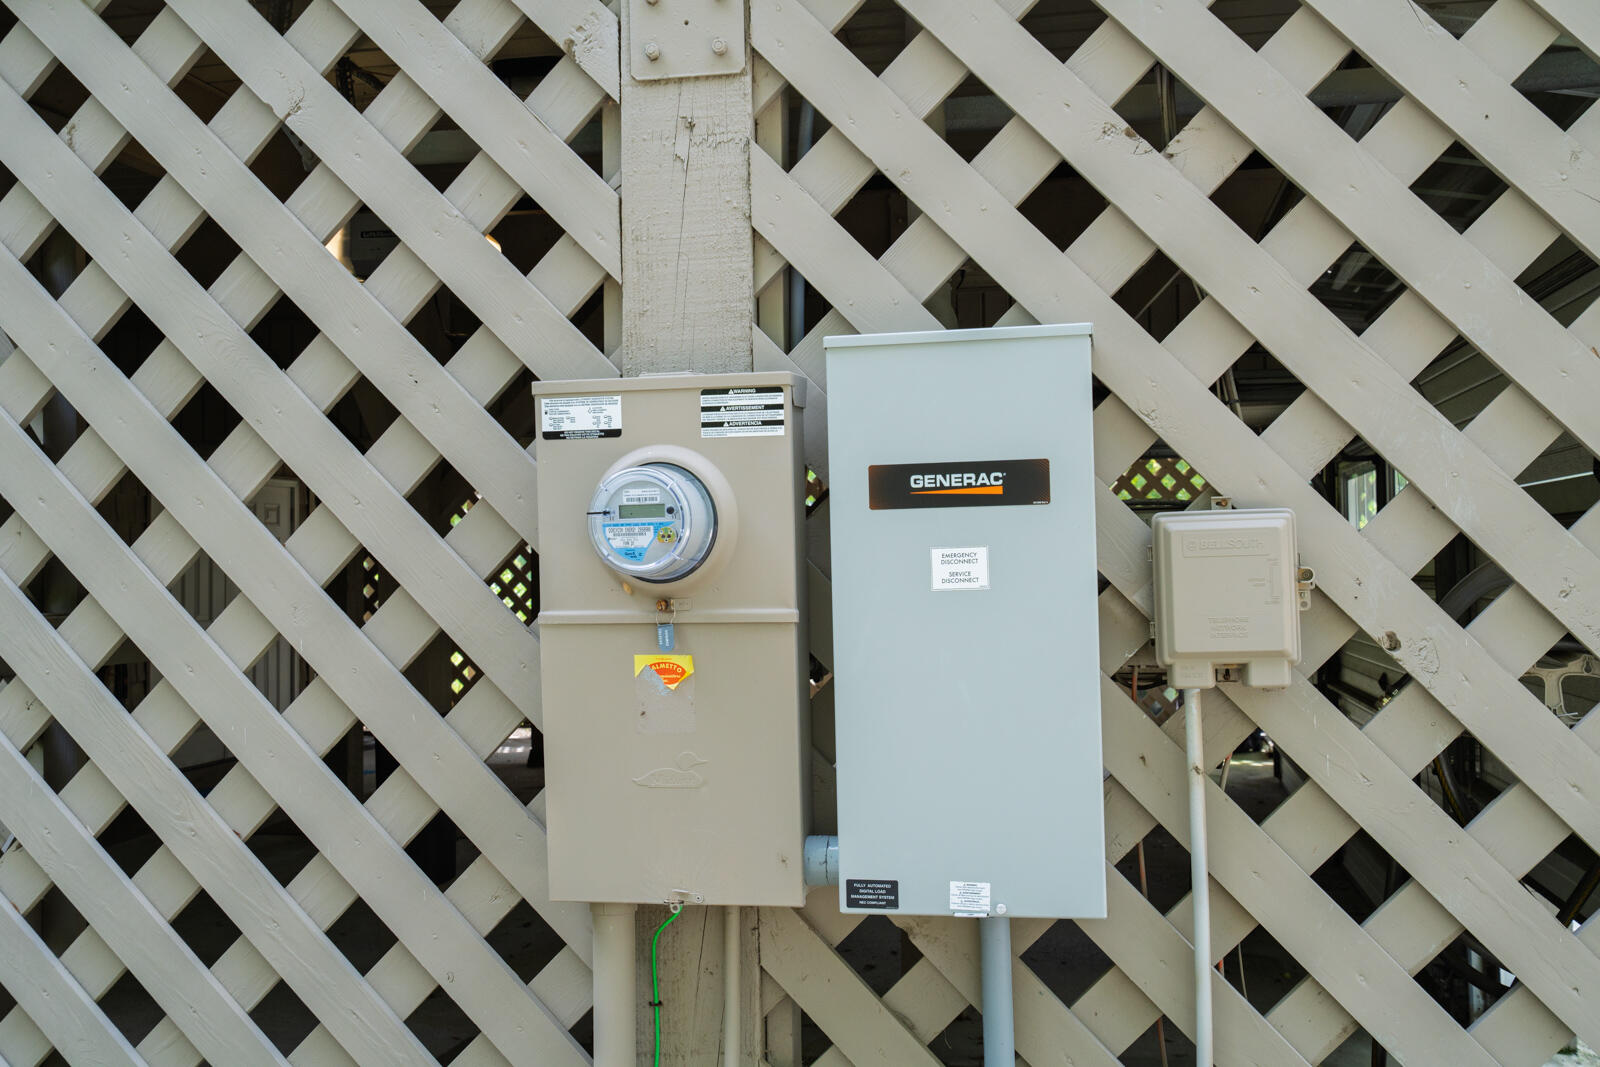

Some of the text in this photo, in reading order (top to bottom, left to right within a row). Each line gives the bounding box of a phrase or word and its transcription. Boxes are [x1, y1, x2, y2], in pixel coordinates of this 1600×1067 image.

[910, 472, 1003, 488] GENERAC
[1200, 537, 1264, 551] BELLSOUTH
[651, 663, 682, 673] ALMETTO
